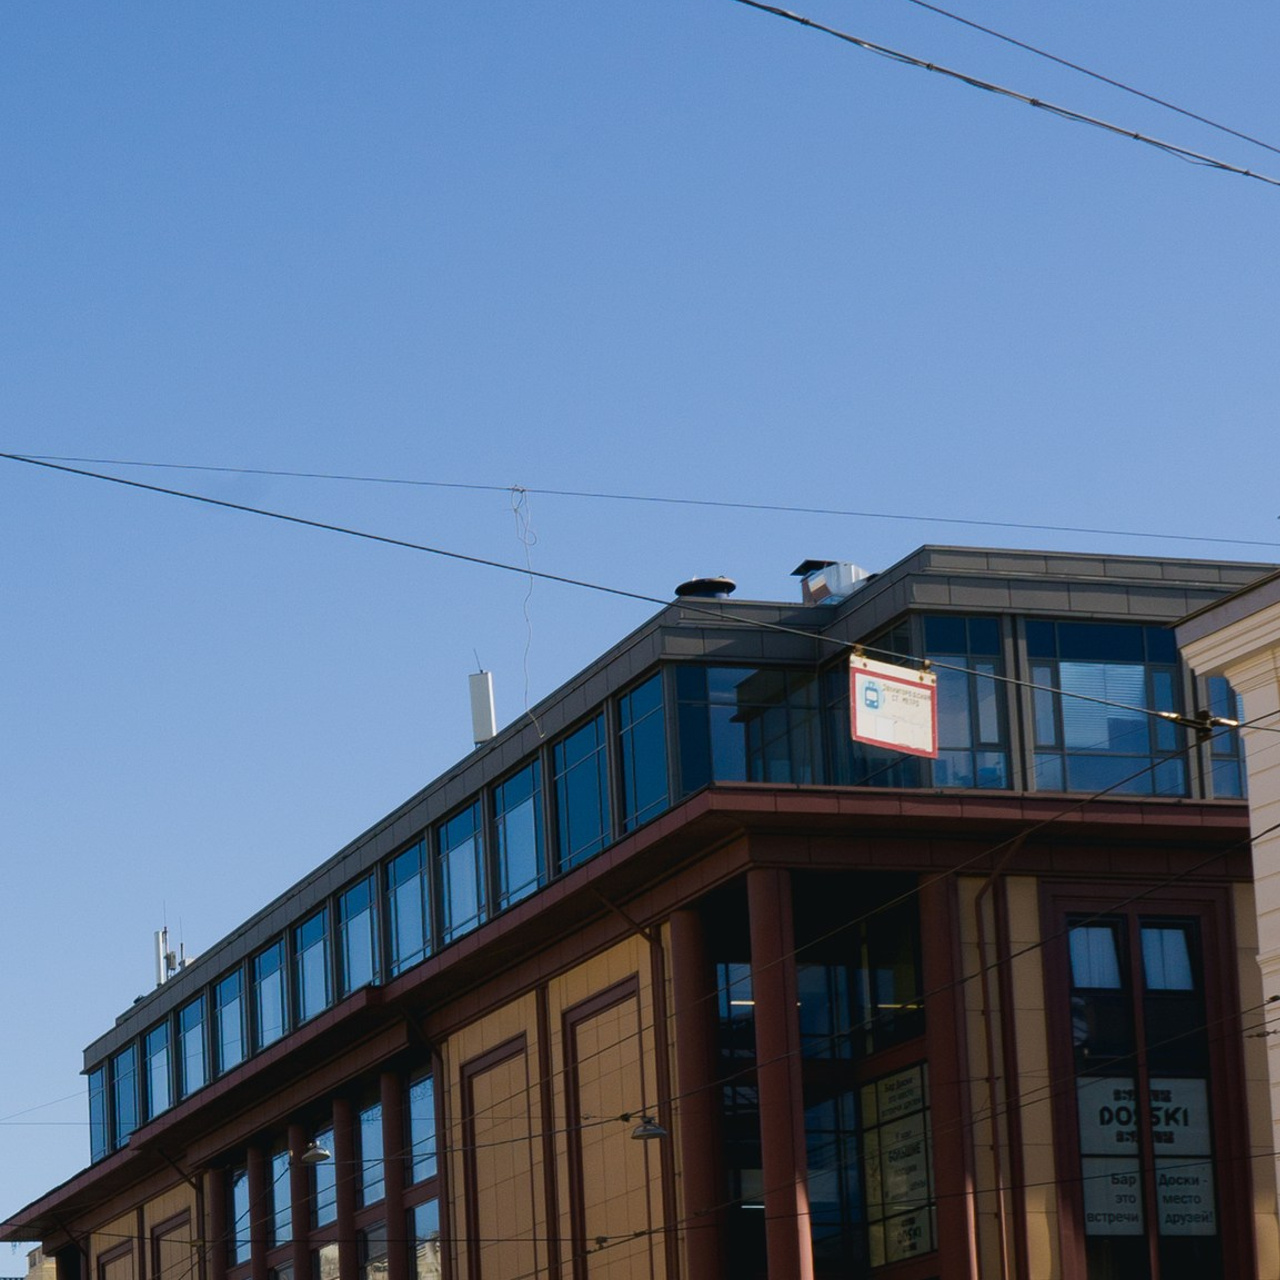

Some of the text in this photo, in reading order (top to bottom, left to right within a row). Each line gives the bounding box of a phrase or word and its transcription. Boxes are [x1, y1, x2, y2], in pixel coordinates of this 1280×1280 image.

[1111, 1173, 1137, 1187] Бар
[1158, 1174, 1199, 1186] Доски
[1115, 1194, 1202, 1205] это место
[1086, 1210, 1214, 1226] встречи друзей!
